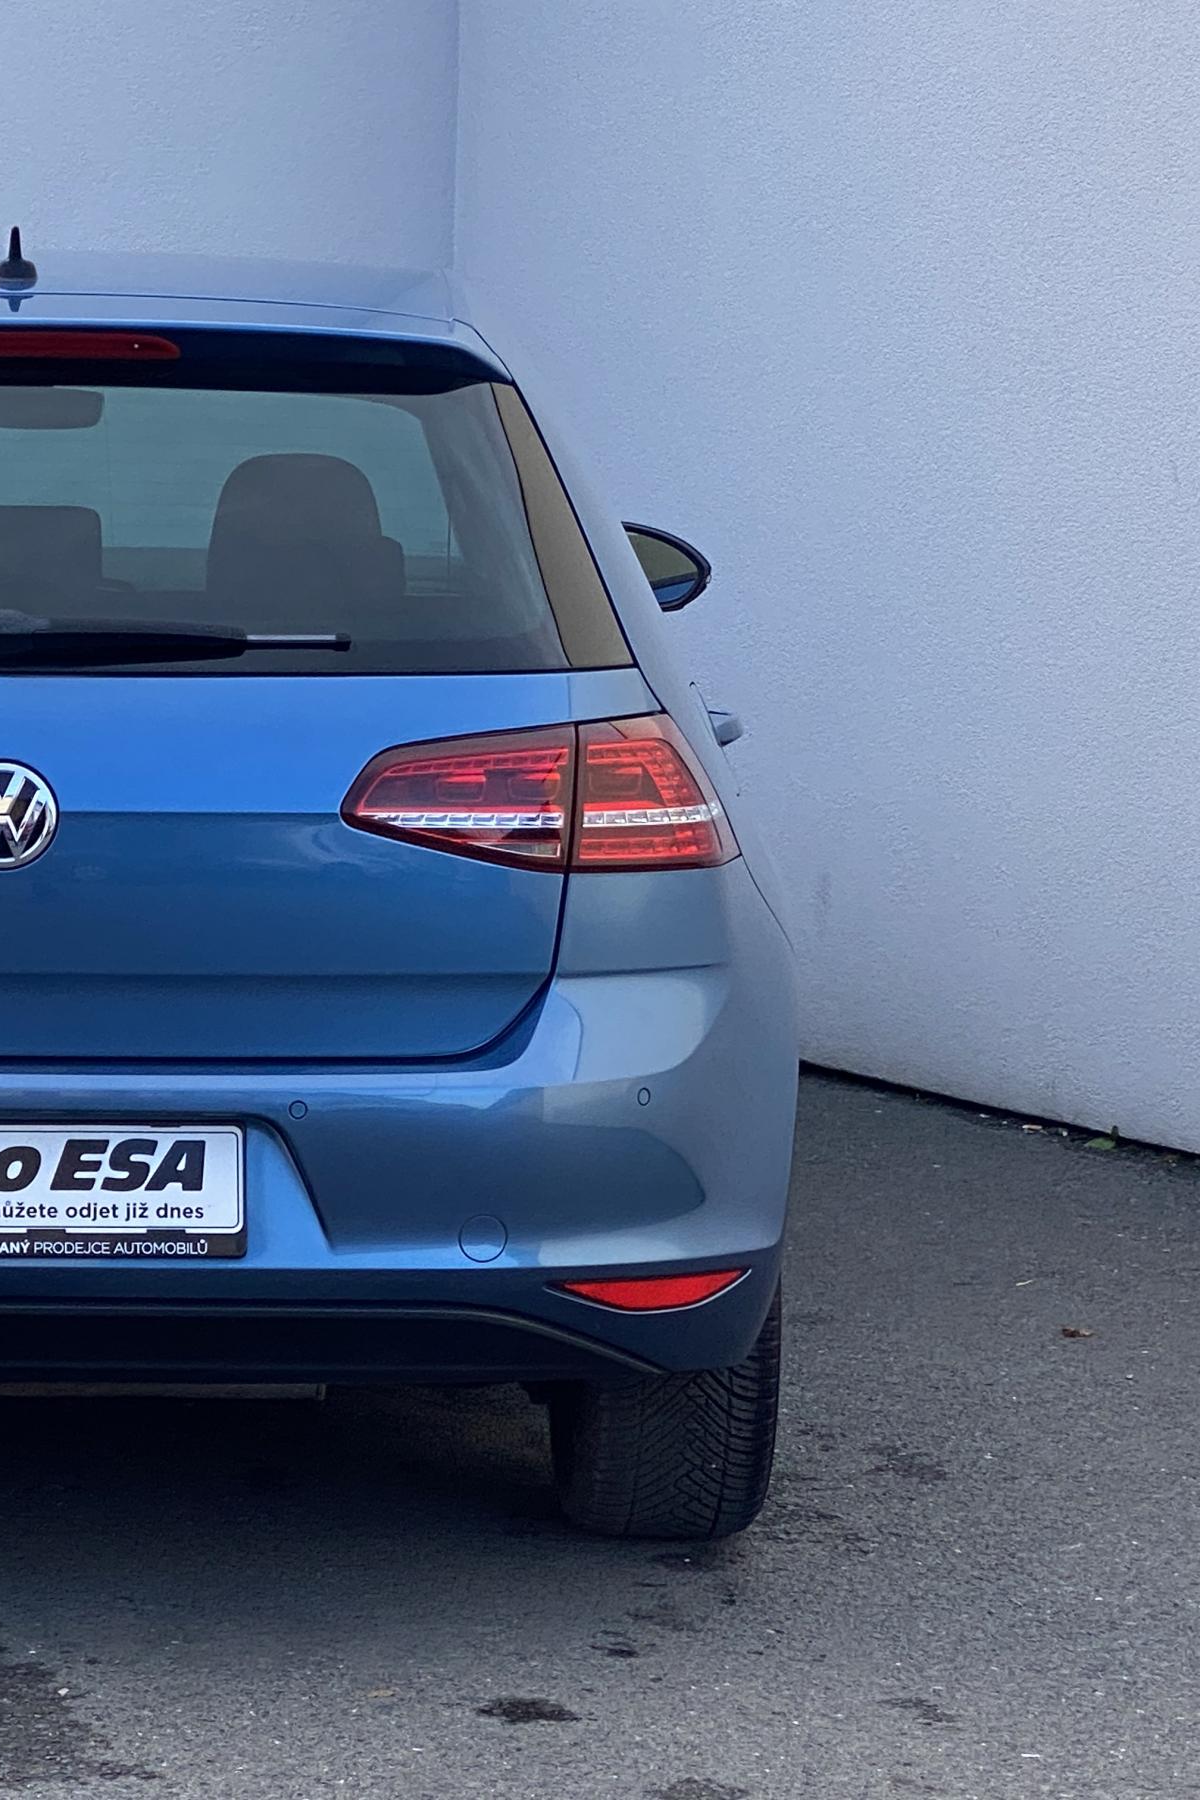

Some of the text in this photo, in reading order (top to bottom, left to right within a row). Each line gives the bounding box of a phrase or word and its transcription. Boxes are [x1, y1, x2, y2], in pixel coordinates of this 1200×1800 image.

[50, 1138, 206, 1192] ESA
[65, 1202, 119, 1221] odjet
[125, 1202, 149, 1221] již
[156, 1202, 204, 1219] dnes
[34, 1241, 110, 1254] PRODEJCE
[114, 1239, 208, 1255] AUTOMOBILŮ
